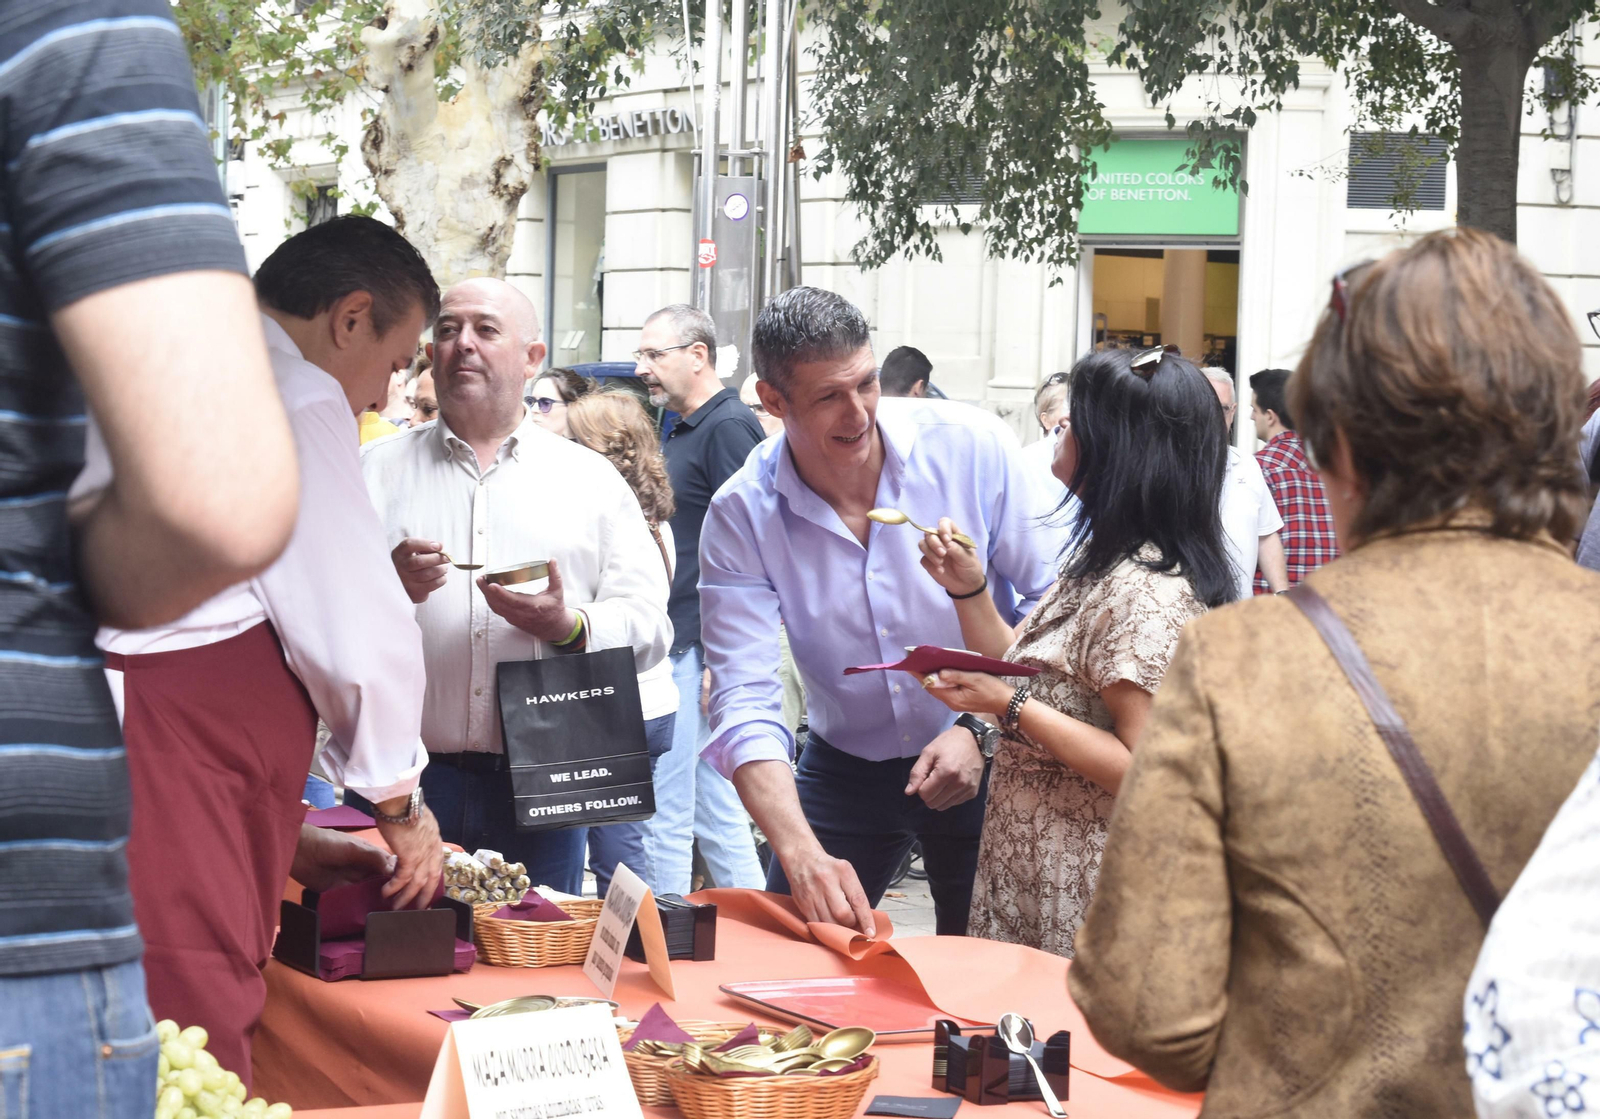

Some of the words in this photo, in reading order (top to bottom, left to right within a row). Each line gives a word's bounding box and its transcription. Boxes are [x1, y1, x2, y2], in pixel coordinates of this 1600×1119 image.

[1087, 173, 1142, 185] UNITED
[1145, 172, 1205, 185] COLORS
[1087, 188, 1107, 200] OF
[1110, 188, 1192, 201] BENETTON.
[525, 686, 615, 705] HAWKERS
[550, 772, 571, 783] WE
[574, 768, 612, 781] LEAD.
[528, 802, 583, 817] OTHERS
[585, 795, 643, 811] FOLLOW.
